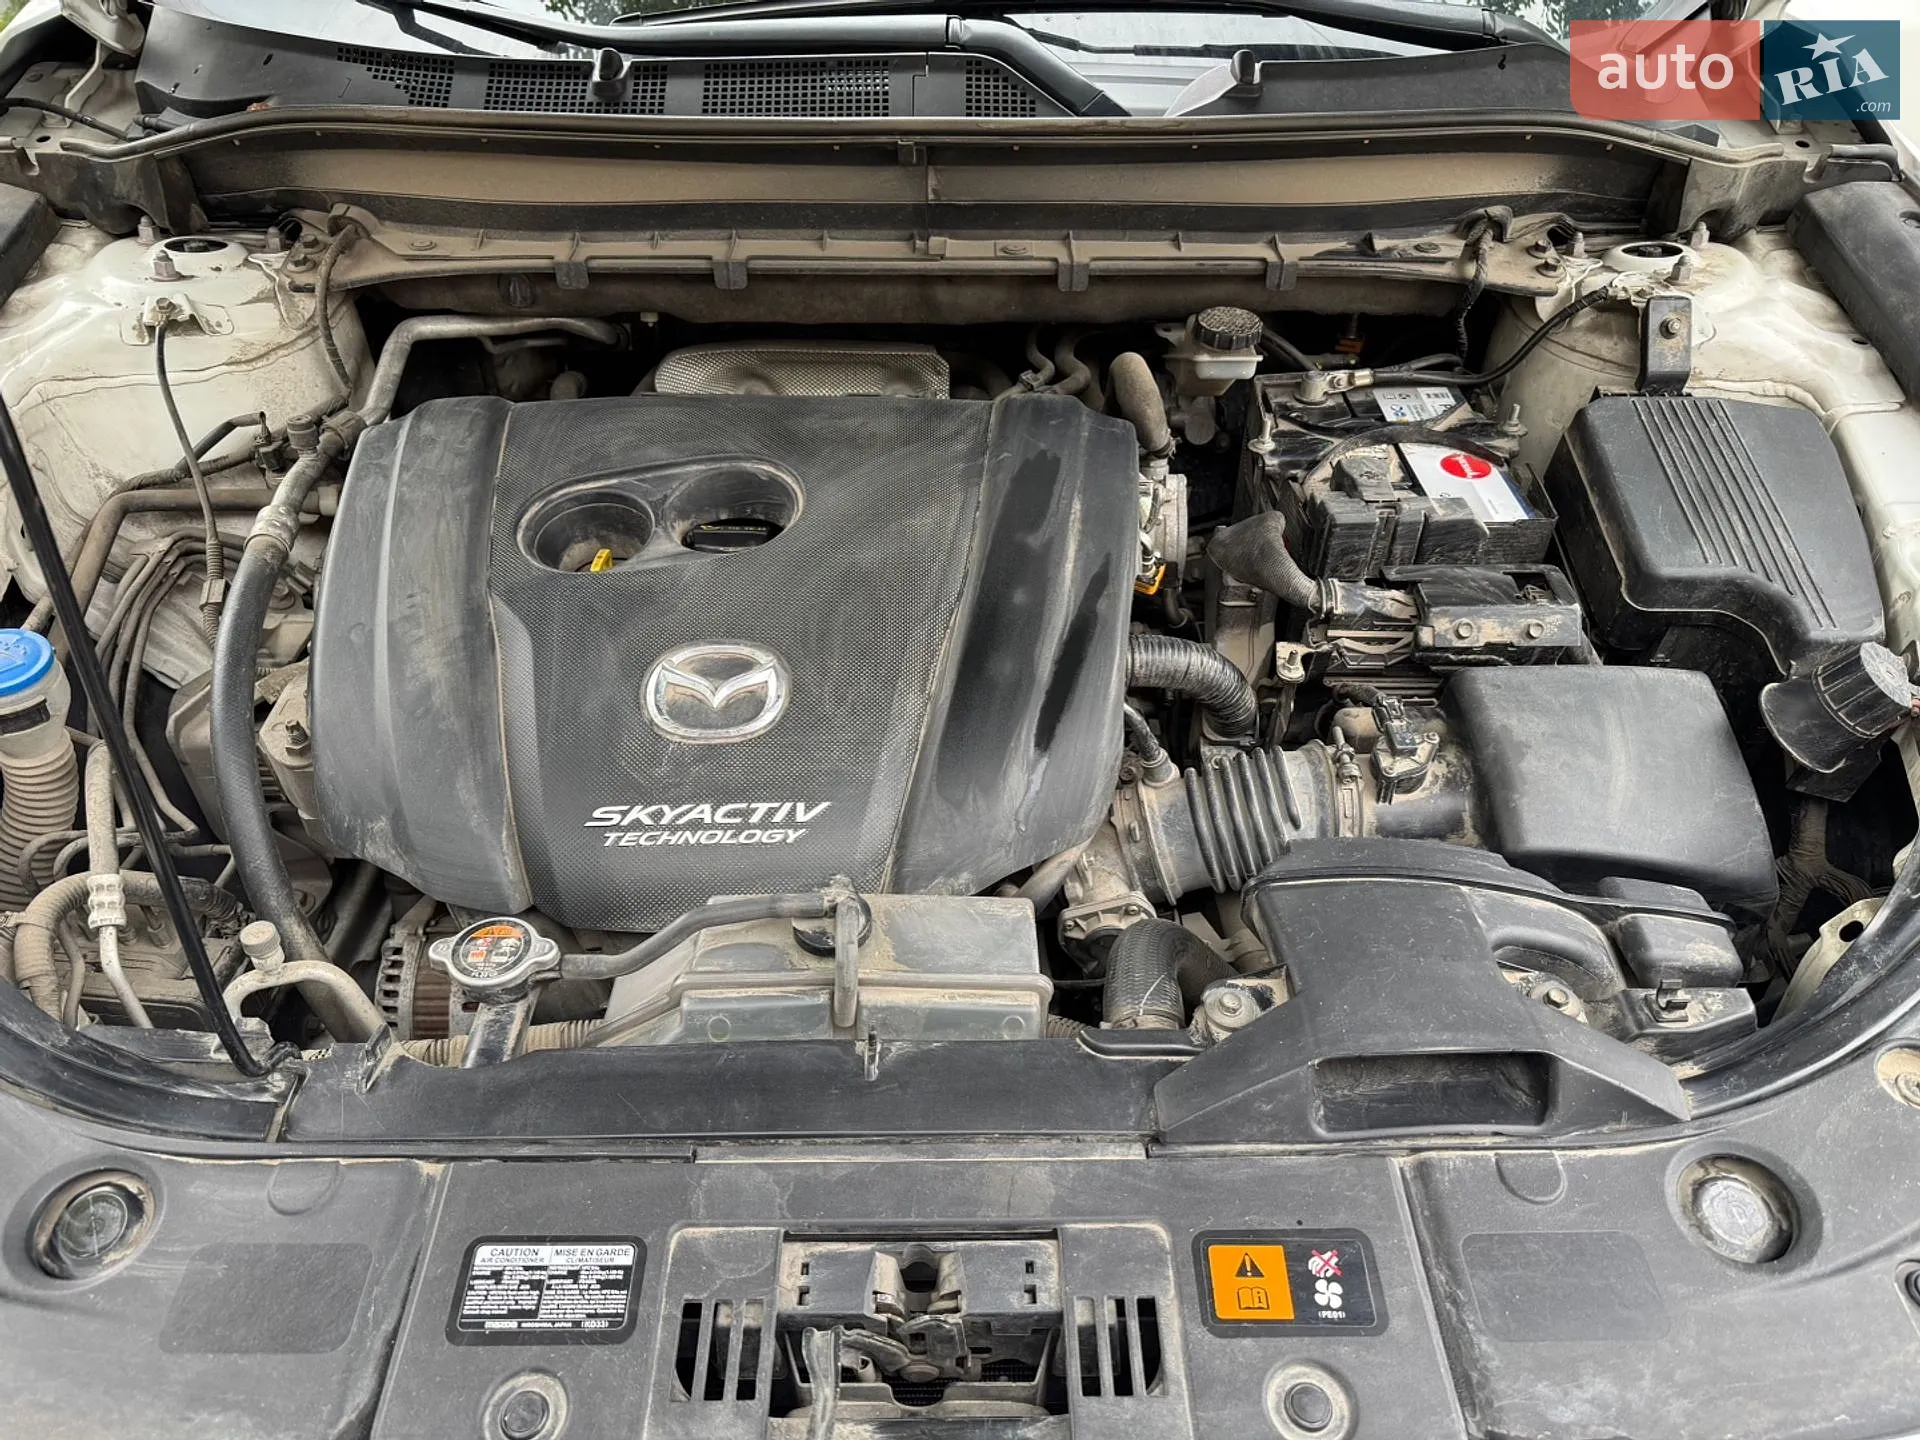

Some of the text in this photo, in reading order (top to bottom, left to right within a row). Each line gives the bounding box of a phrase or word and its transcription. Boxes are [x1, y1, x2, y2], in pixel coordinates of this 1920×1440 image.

[584, 801, 833, 827] SKYACTIV
[603, 828, 807, 847] TECHNOLOGY
[490, 1248, 540, 1257] CAUTION
[553, 1247, 631, 1257] MISE EN GARDE
